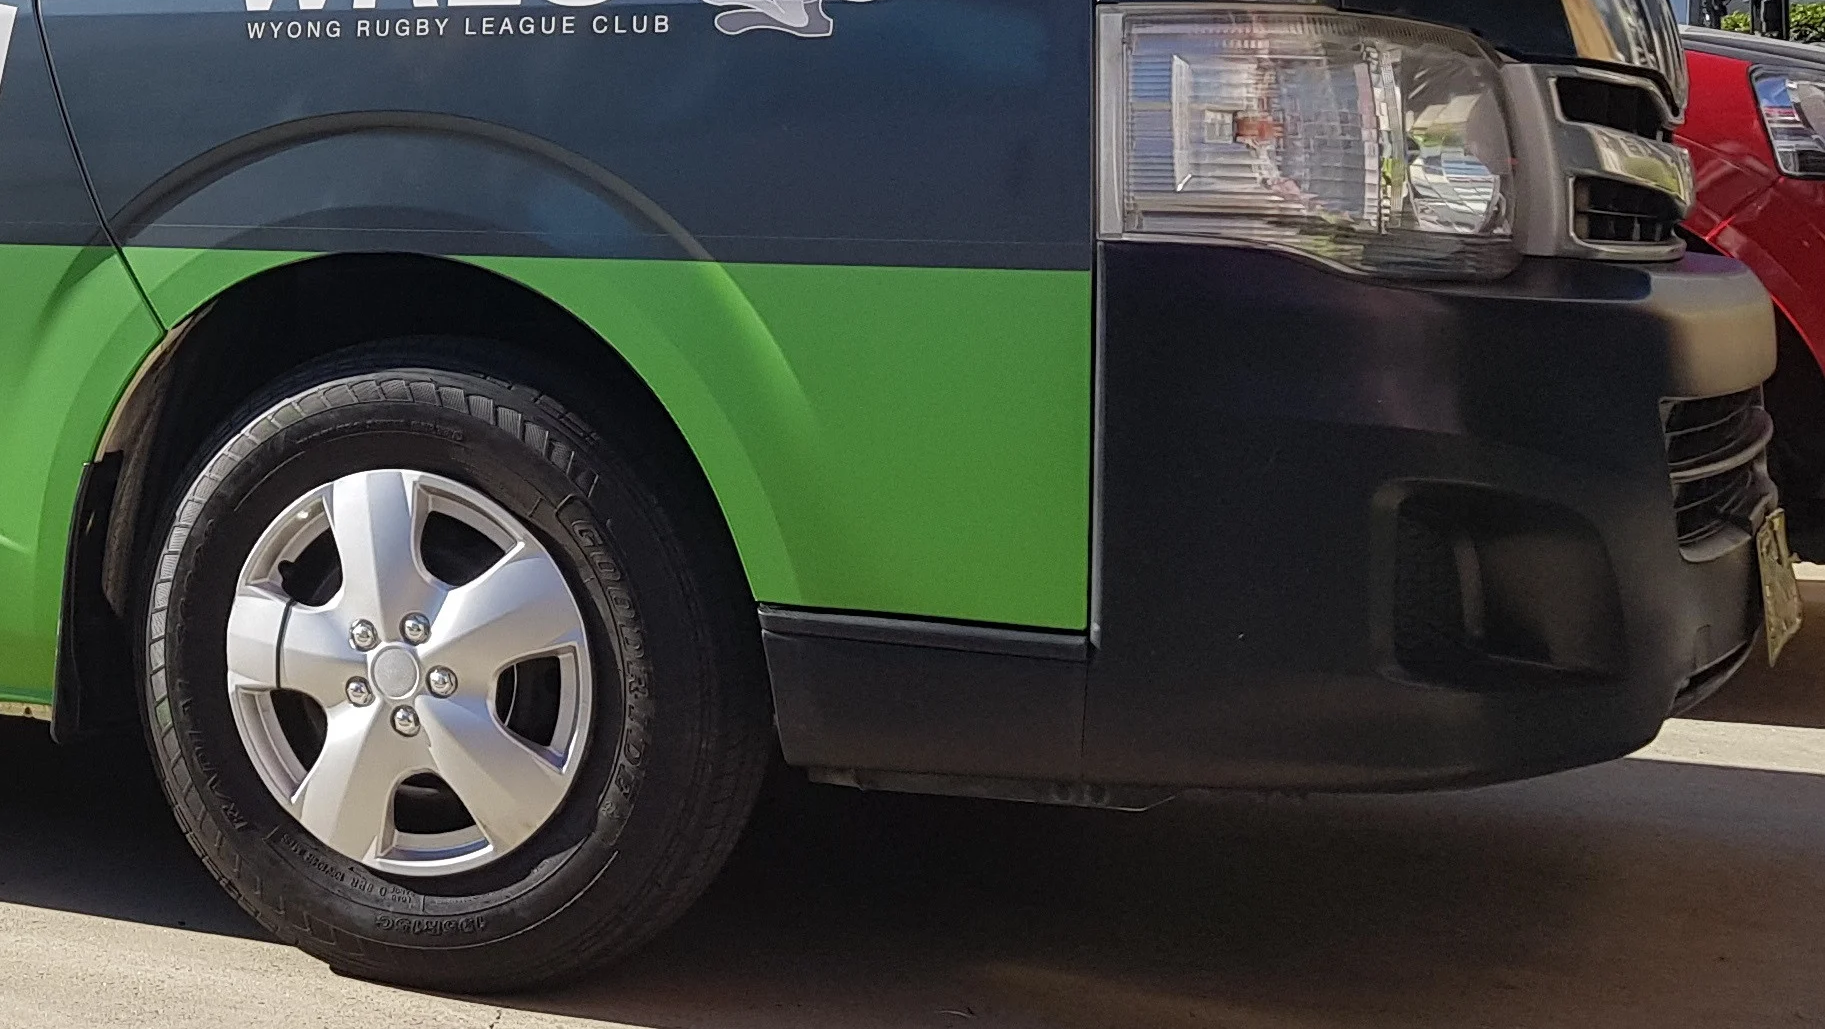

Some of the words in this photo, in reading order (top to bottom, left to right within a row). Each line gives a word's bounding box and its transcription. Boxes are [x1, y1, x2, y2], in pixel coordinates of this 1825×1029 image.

[247, 21, 341, 39] WYONG
[357, 18, 450, 37] RUGBY
[465, 16, 575, 36] LEAGUE
[592, 15, 670, 34] CLUB
[572, 519, 649, 796] GOODRIDE
